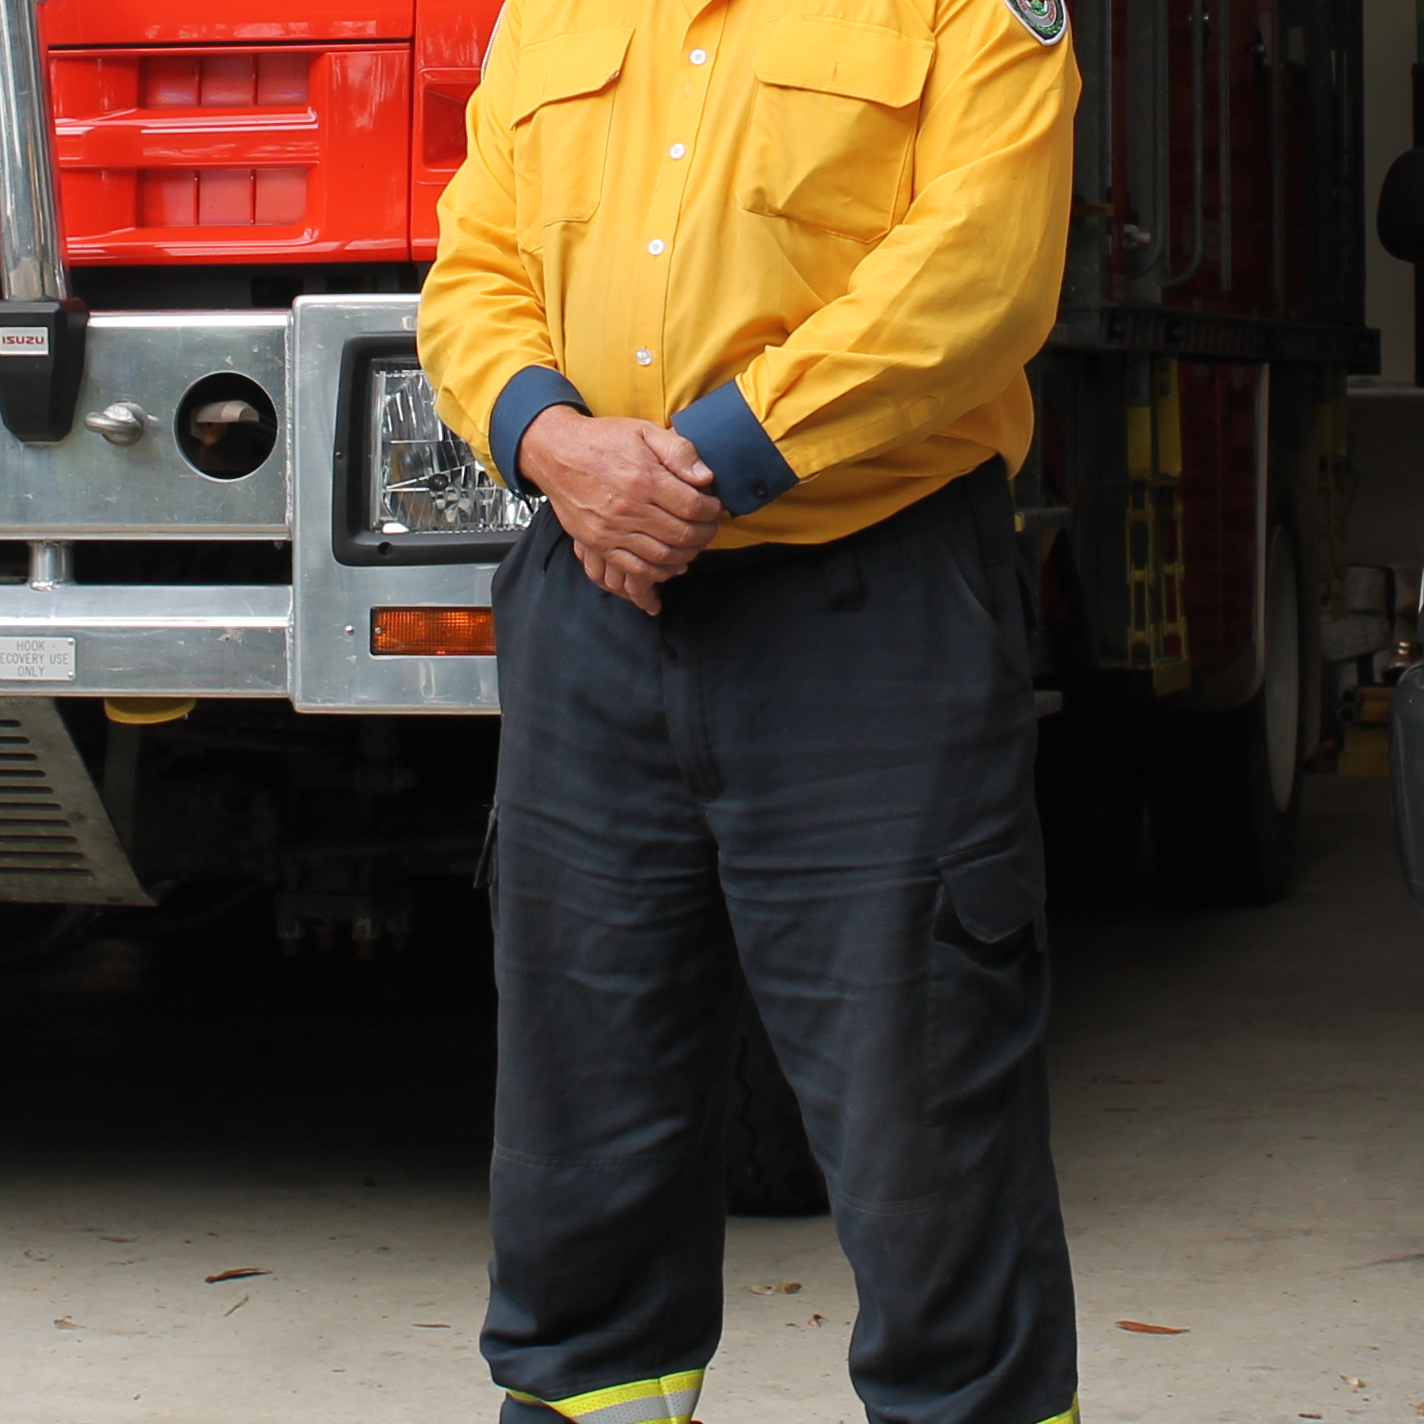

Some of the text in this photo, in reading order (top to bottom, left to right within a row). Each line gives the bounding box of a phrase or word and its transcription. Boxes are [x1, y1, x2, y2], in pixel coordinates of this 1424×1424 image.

[2, 336, 45, 345] ISUZU
[16, 640, 45, 652] HOOK
[49, 653, 69, 665] USE
[17, 665, 45, 677] ONLY
